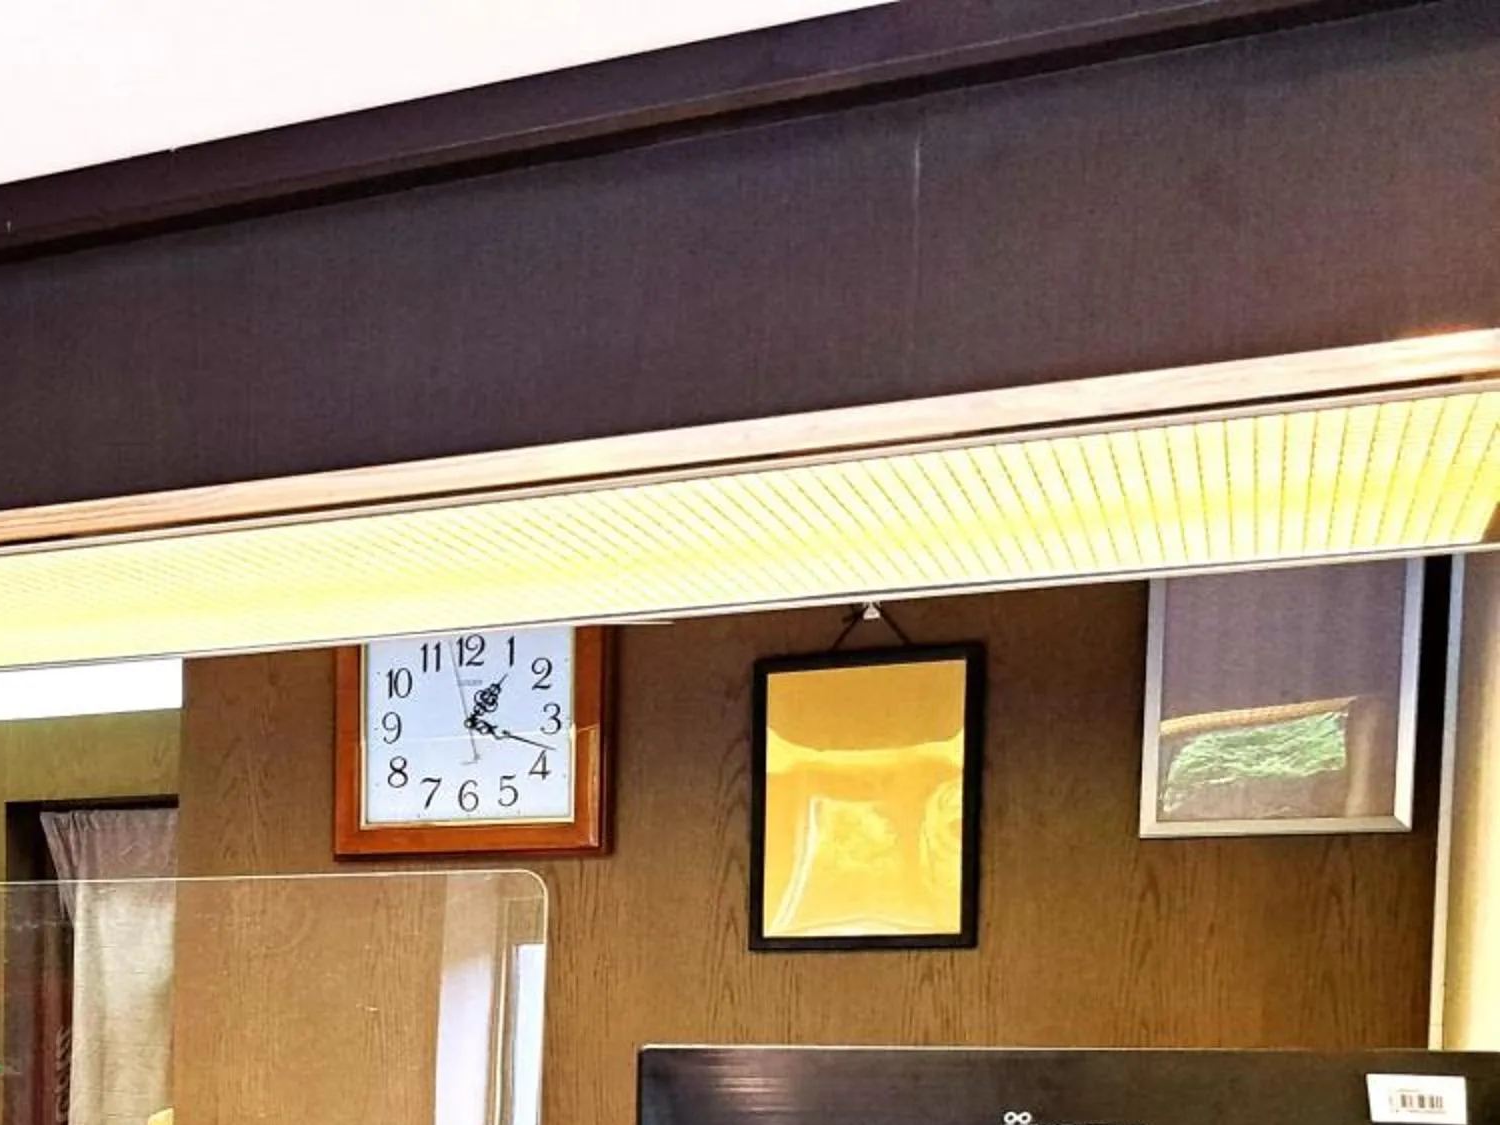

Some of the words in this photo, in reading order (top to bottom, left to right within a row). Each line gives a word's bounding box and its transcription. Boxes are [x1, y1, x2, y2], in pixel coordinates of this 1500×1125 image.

[420, 641, 442, 673] 11
[456, 633, 486, 667] 12
[506, 635, 516, 667] 1
[386, 667, 413, 699] 10
[531, 657, 553, 691] 2
[381, 711, 402, 744] 9
[540, 702, 562, 735] 3
[387, 756, 409, 788] 8
[528, 751, 551, 780] 4
[420, 777, 442, 809] 7
[458, 780, 479, 812] 6
[497, 775, 519, 807] 5
